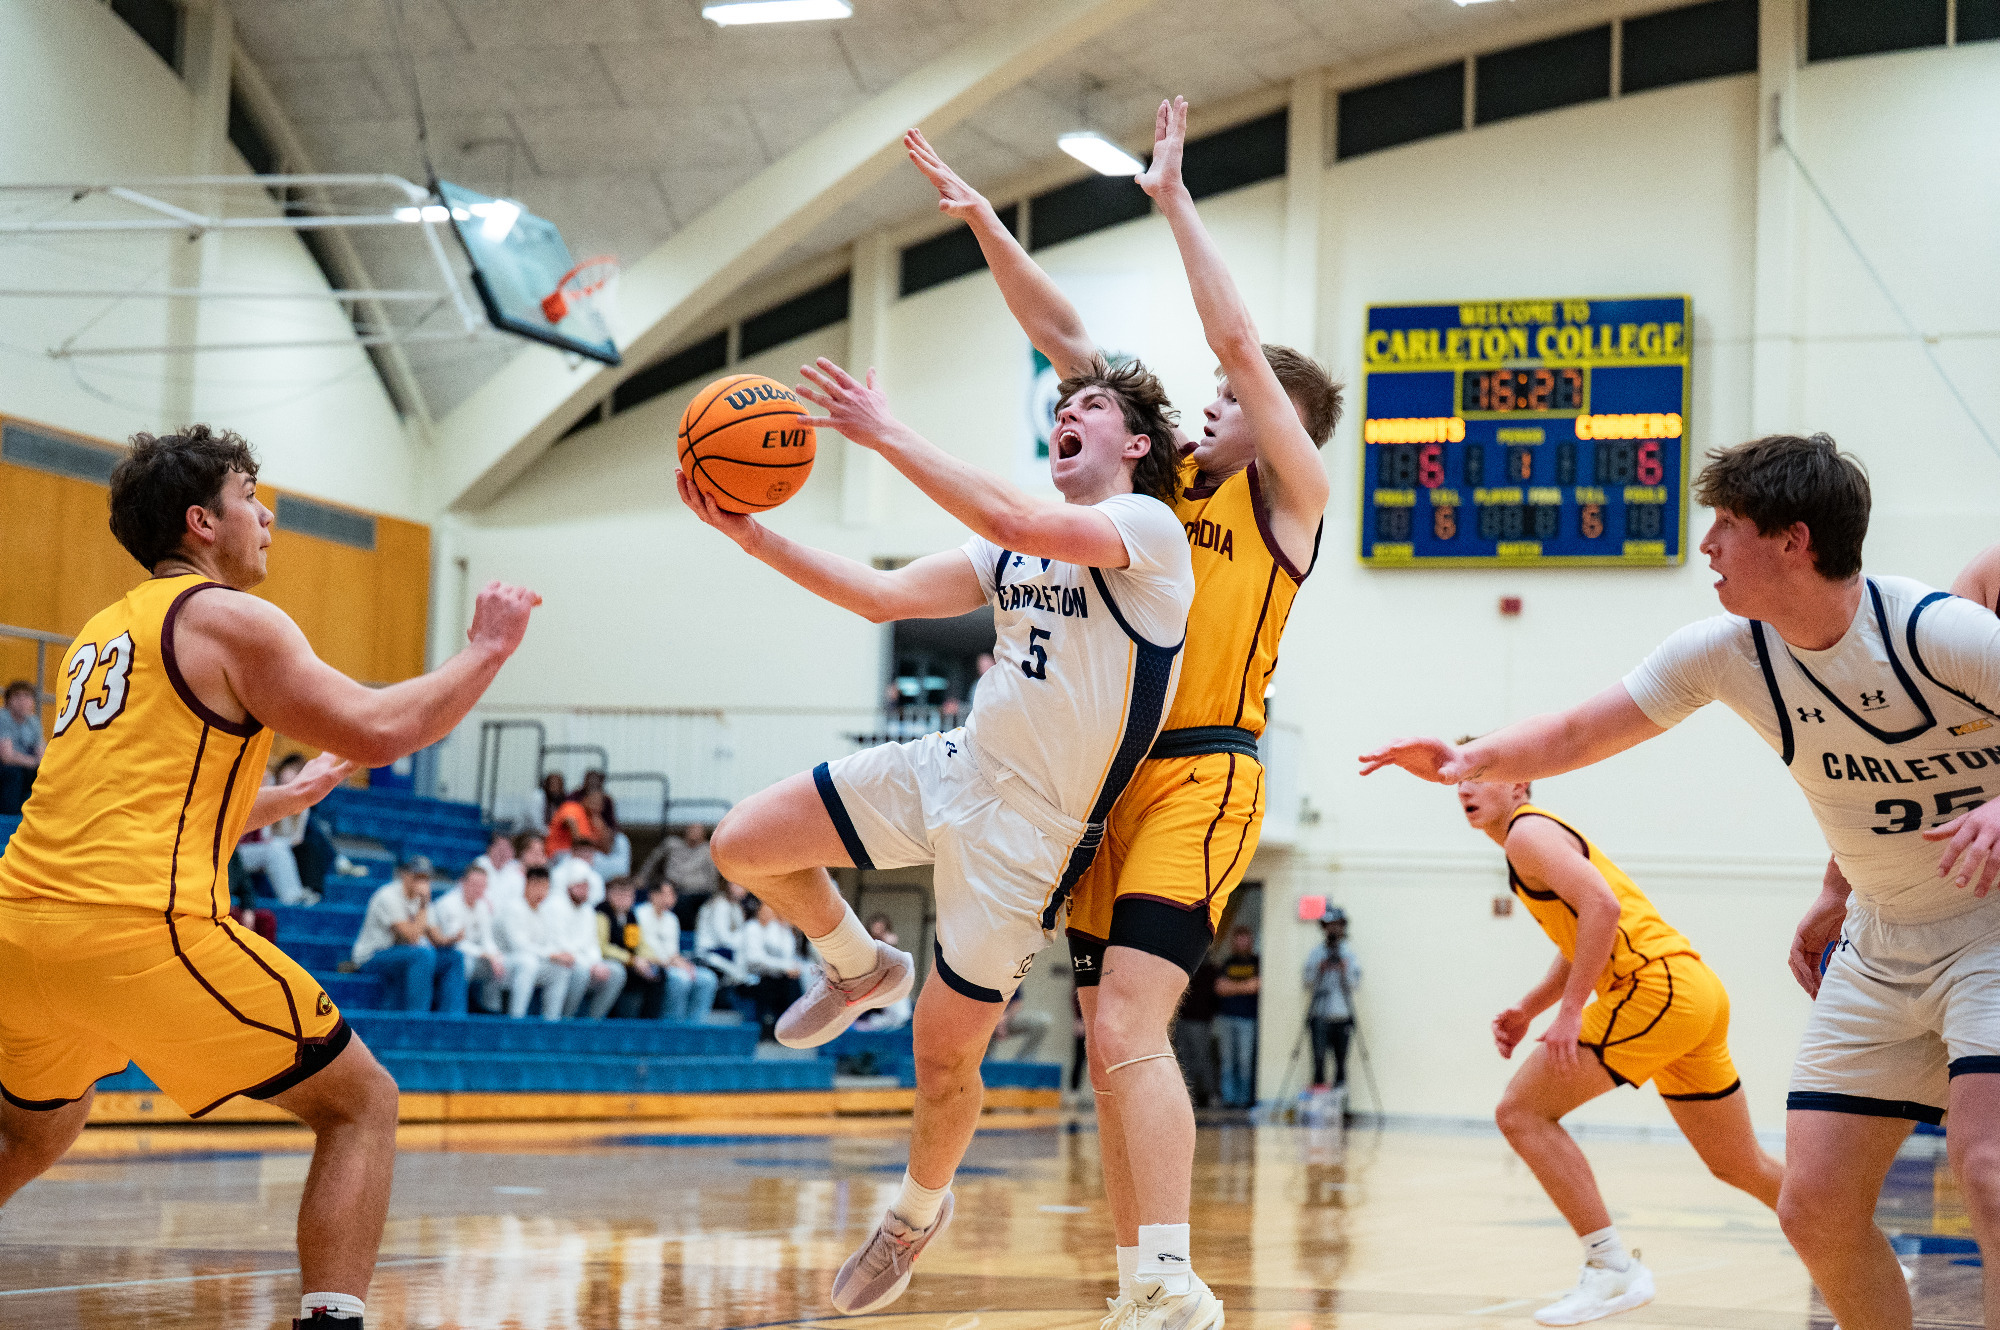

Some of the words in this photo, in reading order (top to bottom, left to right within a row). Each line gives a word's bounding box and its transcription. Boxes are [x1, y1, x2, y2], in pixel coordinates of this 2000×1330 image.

[1563, 300, 1590, 323] TO
[1365, 328, 1529, 364] CARLETON
[1536, 322, 1684, 361] COLLEGE
[762, 429, 806, 448] EVO
[1637, 440, 1663, 485] 6
[1000, 584, 1089, 619] CARLETON
[1021, 625, 1052, 680] 5
[53, 630, 136, 739] 33
